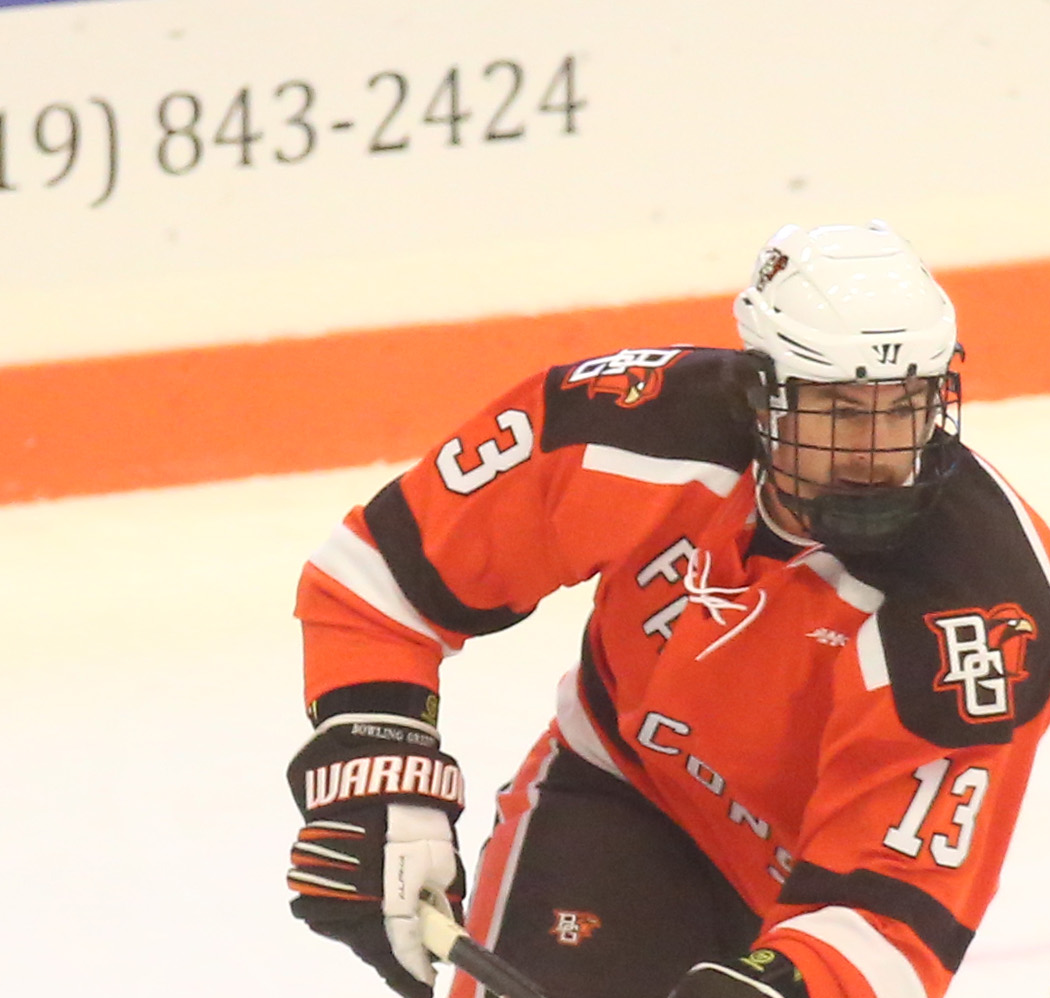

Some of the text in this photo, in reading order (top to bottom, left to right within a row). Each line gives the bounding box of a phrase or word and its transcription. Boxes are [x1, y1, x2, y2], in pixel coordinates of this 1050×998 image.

[156, 54, 589, 177] 843-2424
[434, 407, 535, 497] 3
[934, 614, 1008, 717] BG
[304, 755, 465, 811] WARRIO
[883, 757, 990, 870] 13
